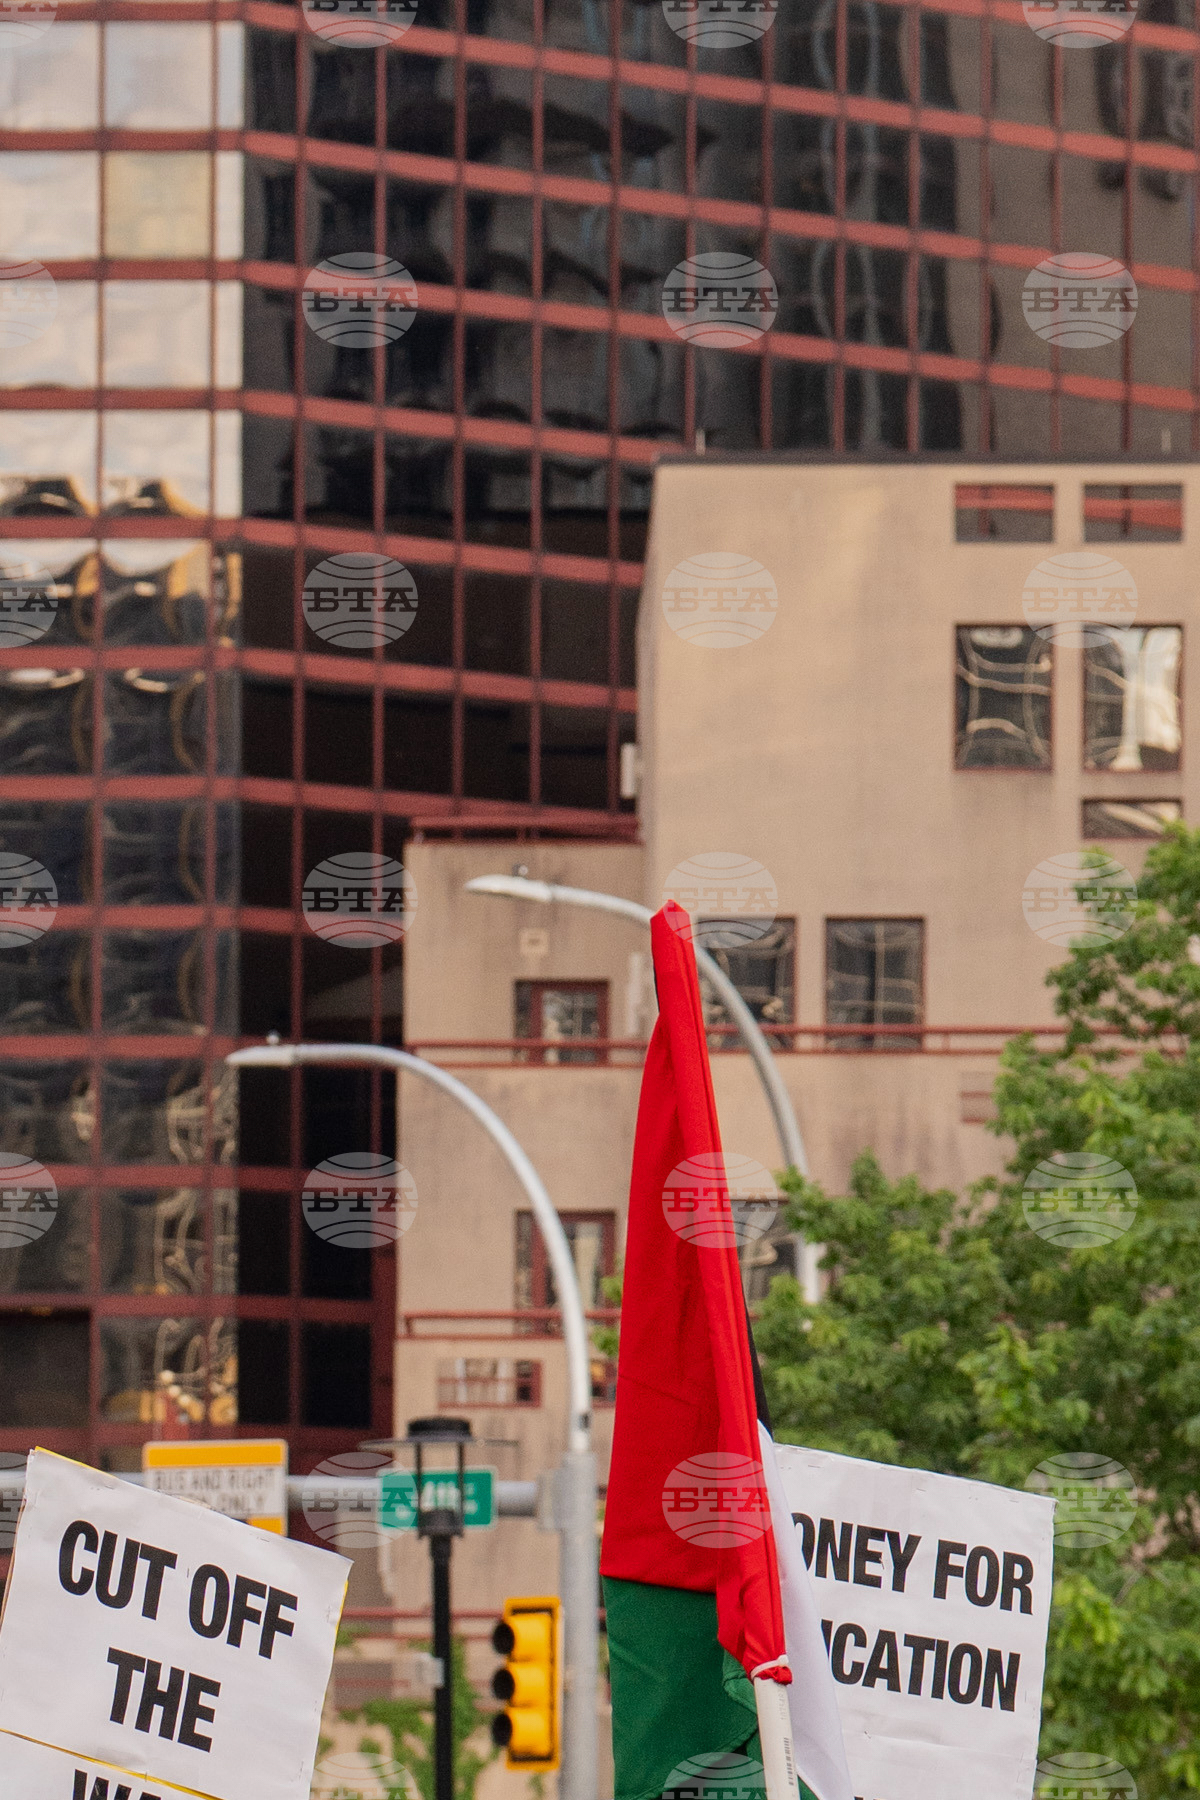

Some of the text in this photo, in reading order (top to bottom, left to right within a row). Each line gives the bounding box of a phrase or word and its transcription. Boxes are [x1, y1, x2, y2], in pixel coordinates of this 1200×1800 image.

[58, 1519, 298, 1660] CUT OFF
[791, 1512, 1034, 1615] ONEY FOR
[106, 1647, 221, 1753] THE
[821, 1618, 1021, 1712] CATION
